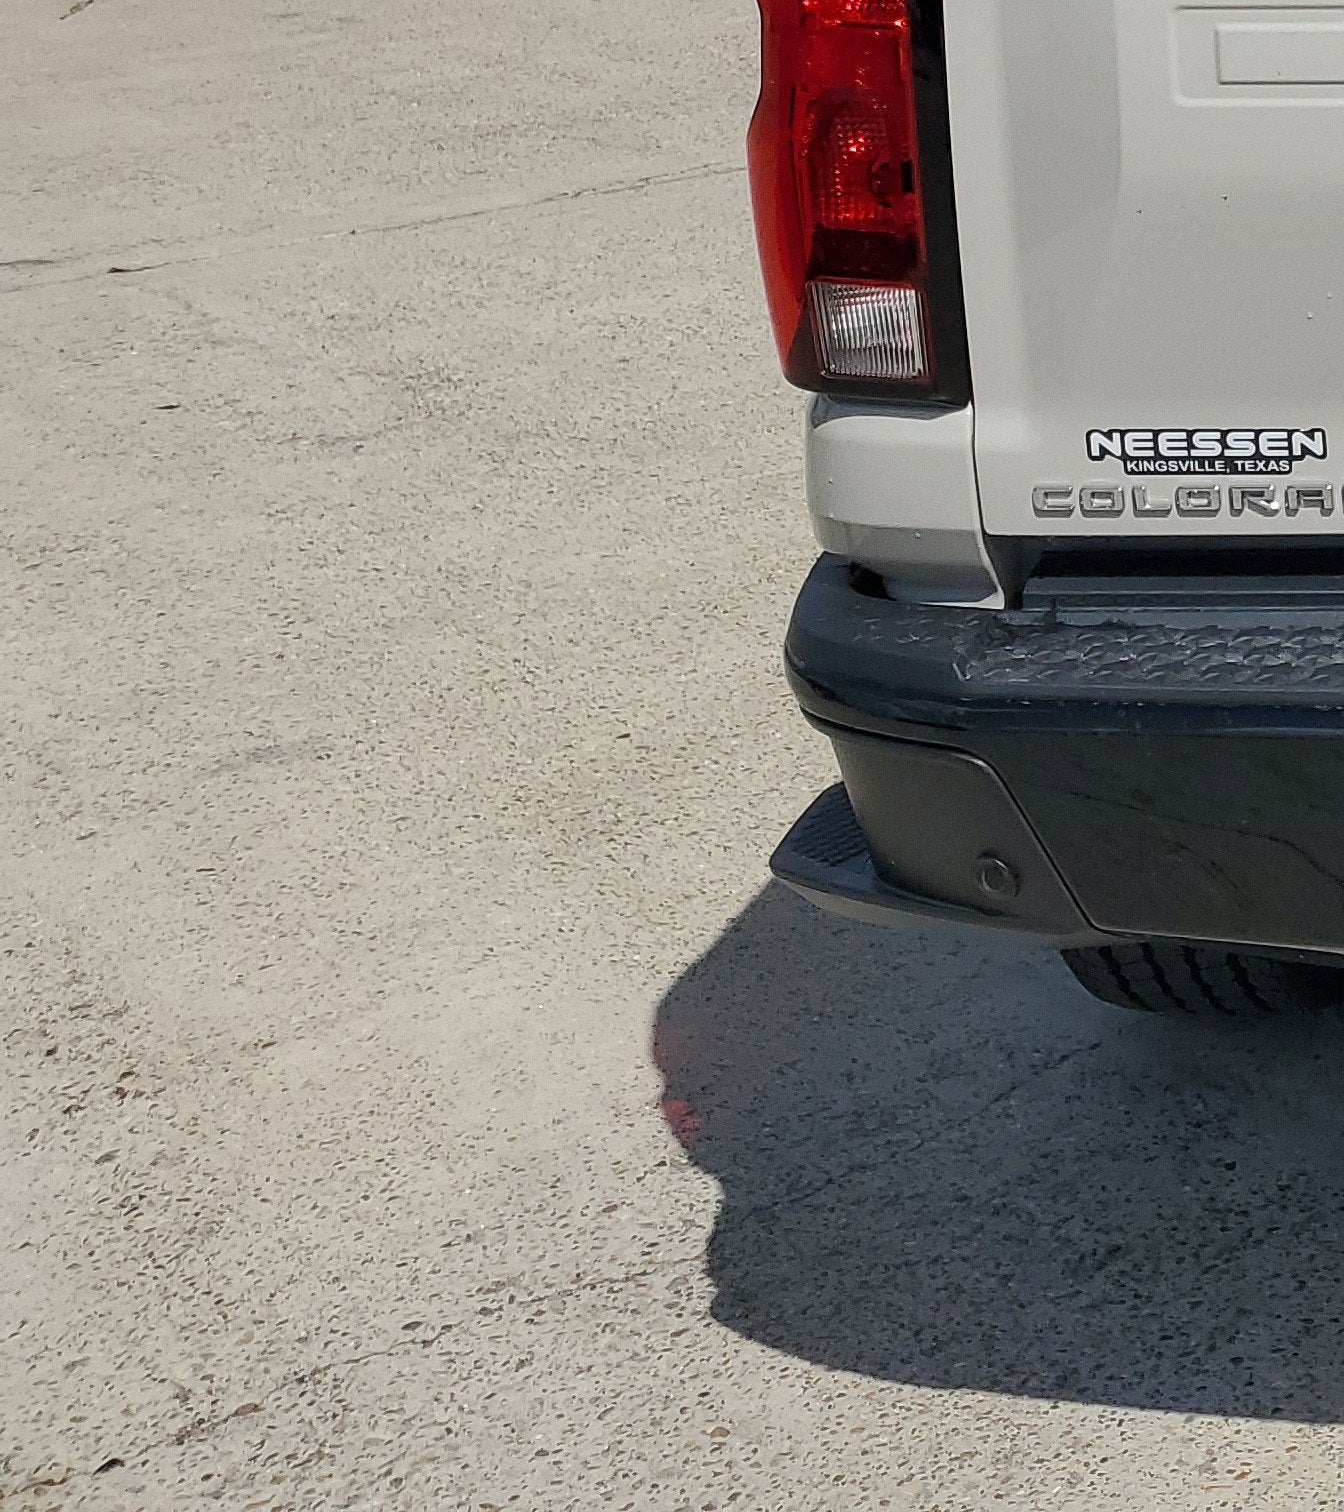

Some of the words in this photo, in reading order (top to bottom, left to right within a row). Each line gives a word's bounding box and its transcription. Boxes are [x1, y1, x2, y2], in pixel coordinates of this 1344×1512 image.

[1091, 430, 1324, 458] NEESSEN
[1126, 460, 1230, 474] KINGSVILLE,
[1234, 460, 1290, 473] TEXAS
